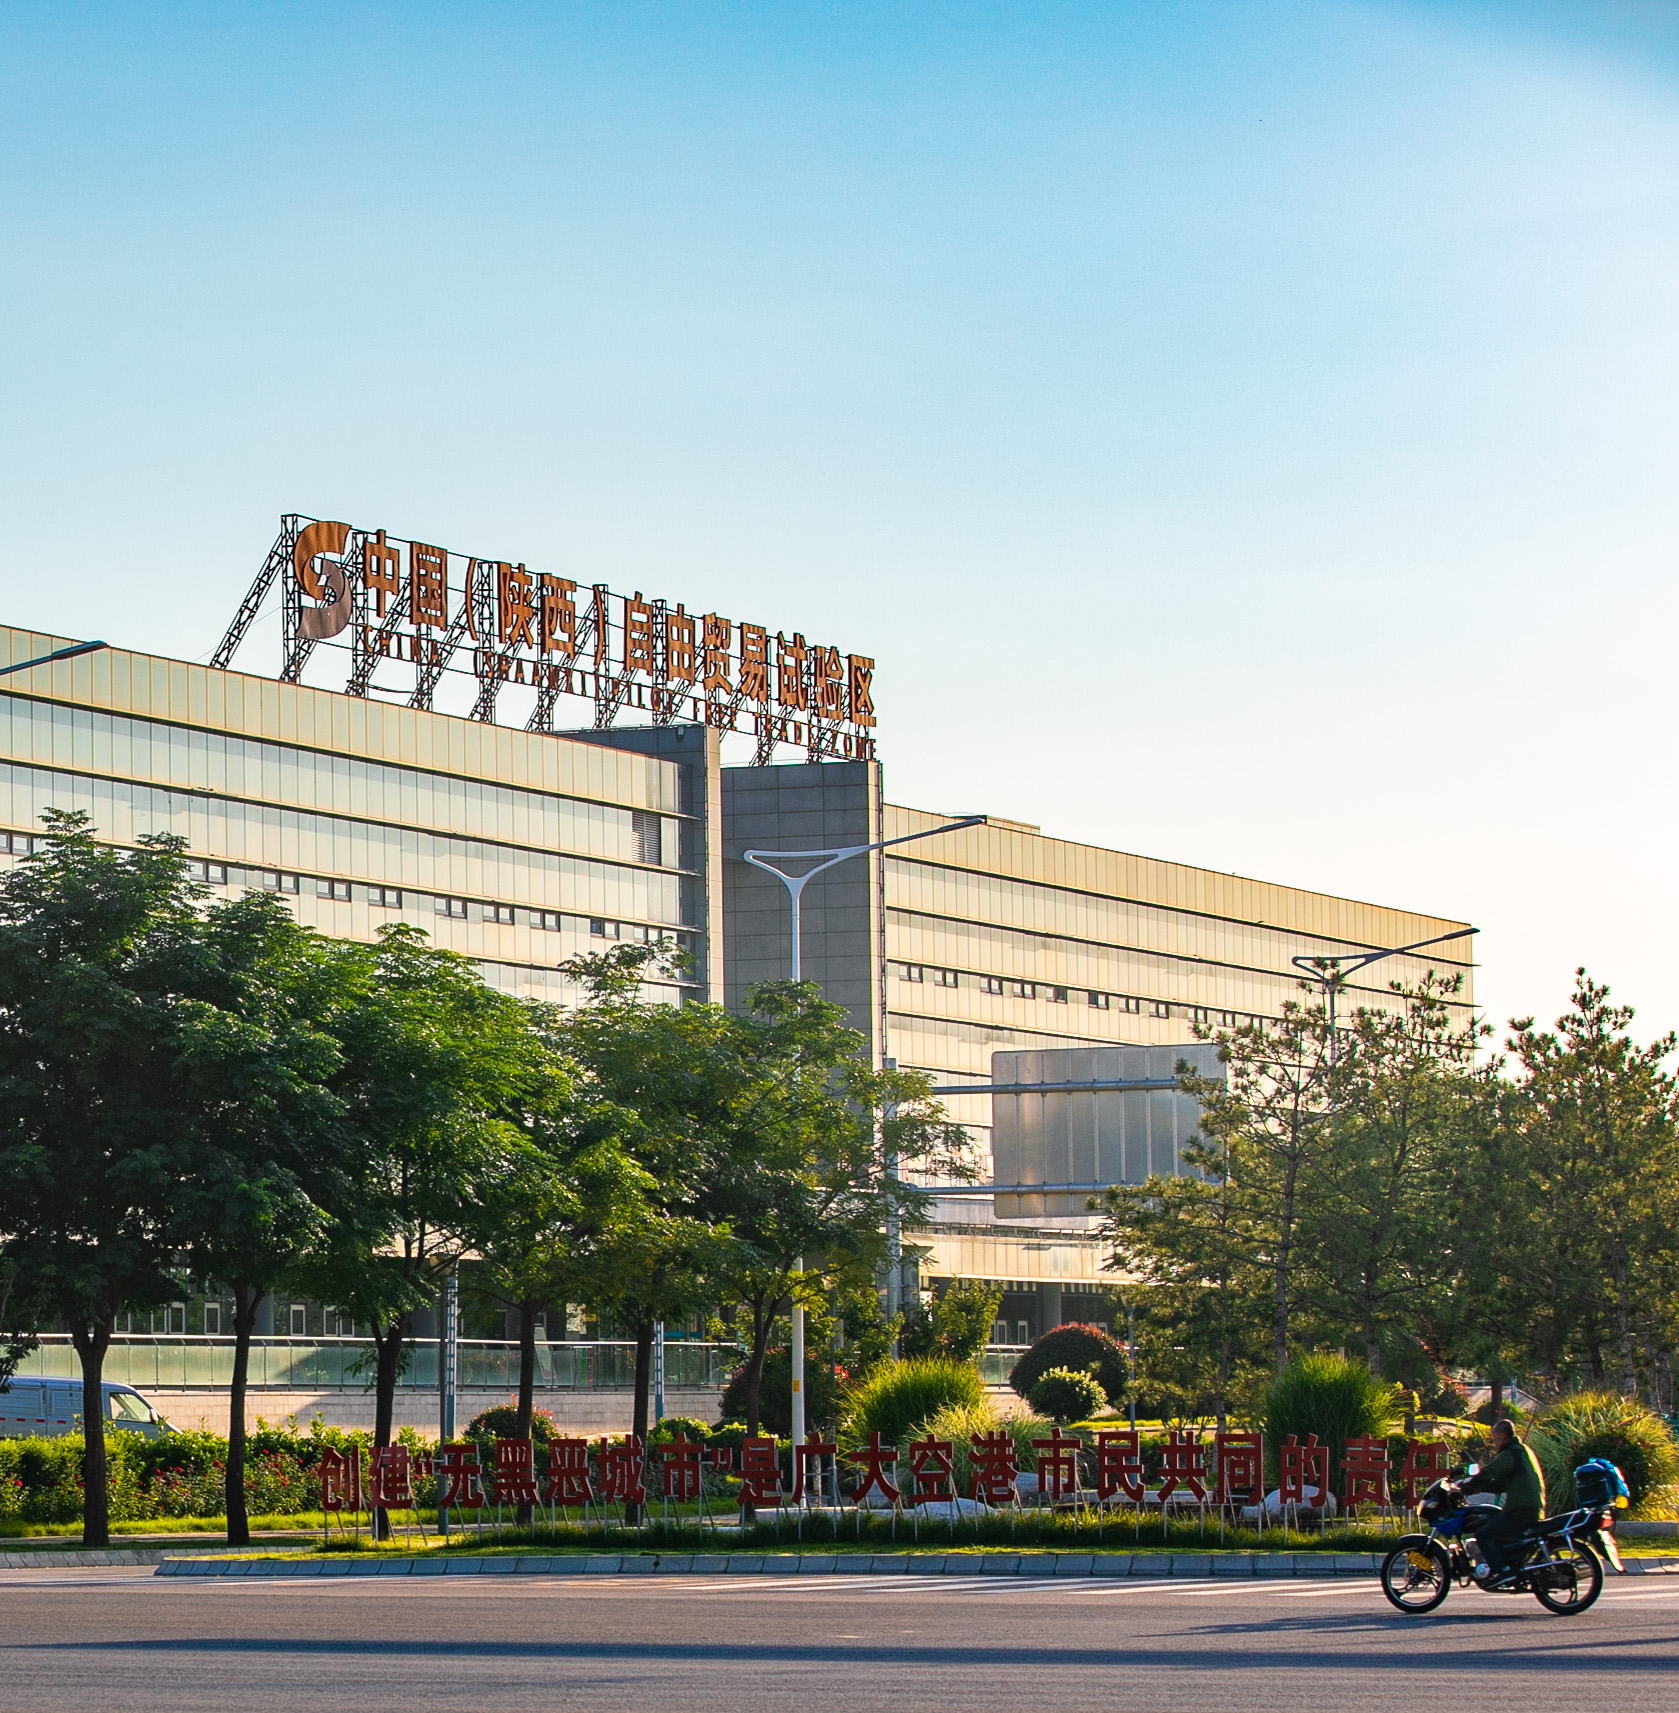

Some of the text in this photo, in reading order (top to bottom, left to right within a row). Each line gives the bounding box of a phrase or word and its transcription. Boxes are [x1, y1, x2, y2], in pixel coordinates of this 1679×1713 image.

[364, 625, 440, 667] CHINA
[611, 677, 673, 715] PILOT
[693, 698, 737, 731] FREE
[754, 712, 814, 748] TRADE
[832, 730, 877, 761] ZONE
